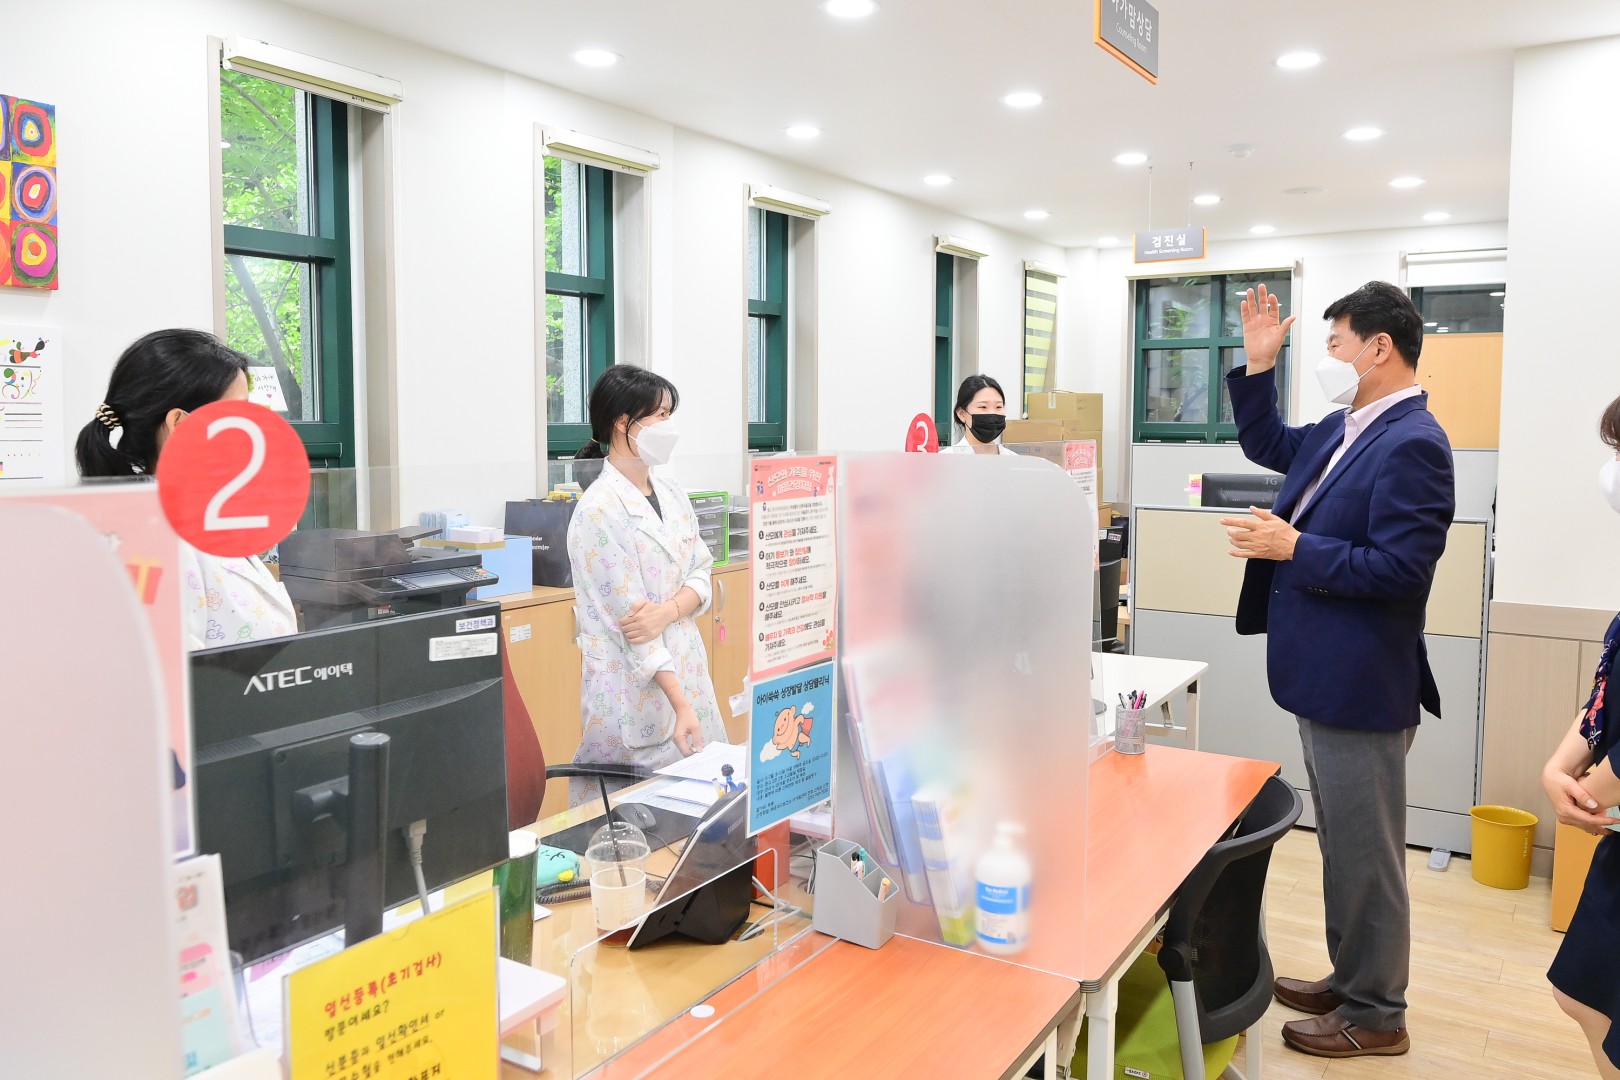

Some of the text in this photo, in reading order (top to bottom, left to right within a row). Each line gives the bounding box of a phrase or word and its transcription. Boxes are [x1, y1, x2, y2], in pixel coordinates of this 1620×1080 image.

[1116, 22, 1148, 52] Counseling Room
[1152, 233, 1186, 248] 검진실
[915, 420, 929, 453] 3
[203, 416, 269, 531] 2
[458, 618, 494, 630] 보건정책과
[243, 662, 353, 695] ATEC 에이텍
[756, 674, 830, 706] 아이쑥쑥 성장발달 상담클리닉
[324, 951, 443, 1019] 임신등록(초기검사)
[326, 1008, 446, 1076] 신분증과 임신확인서 or
